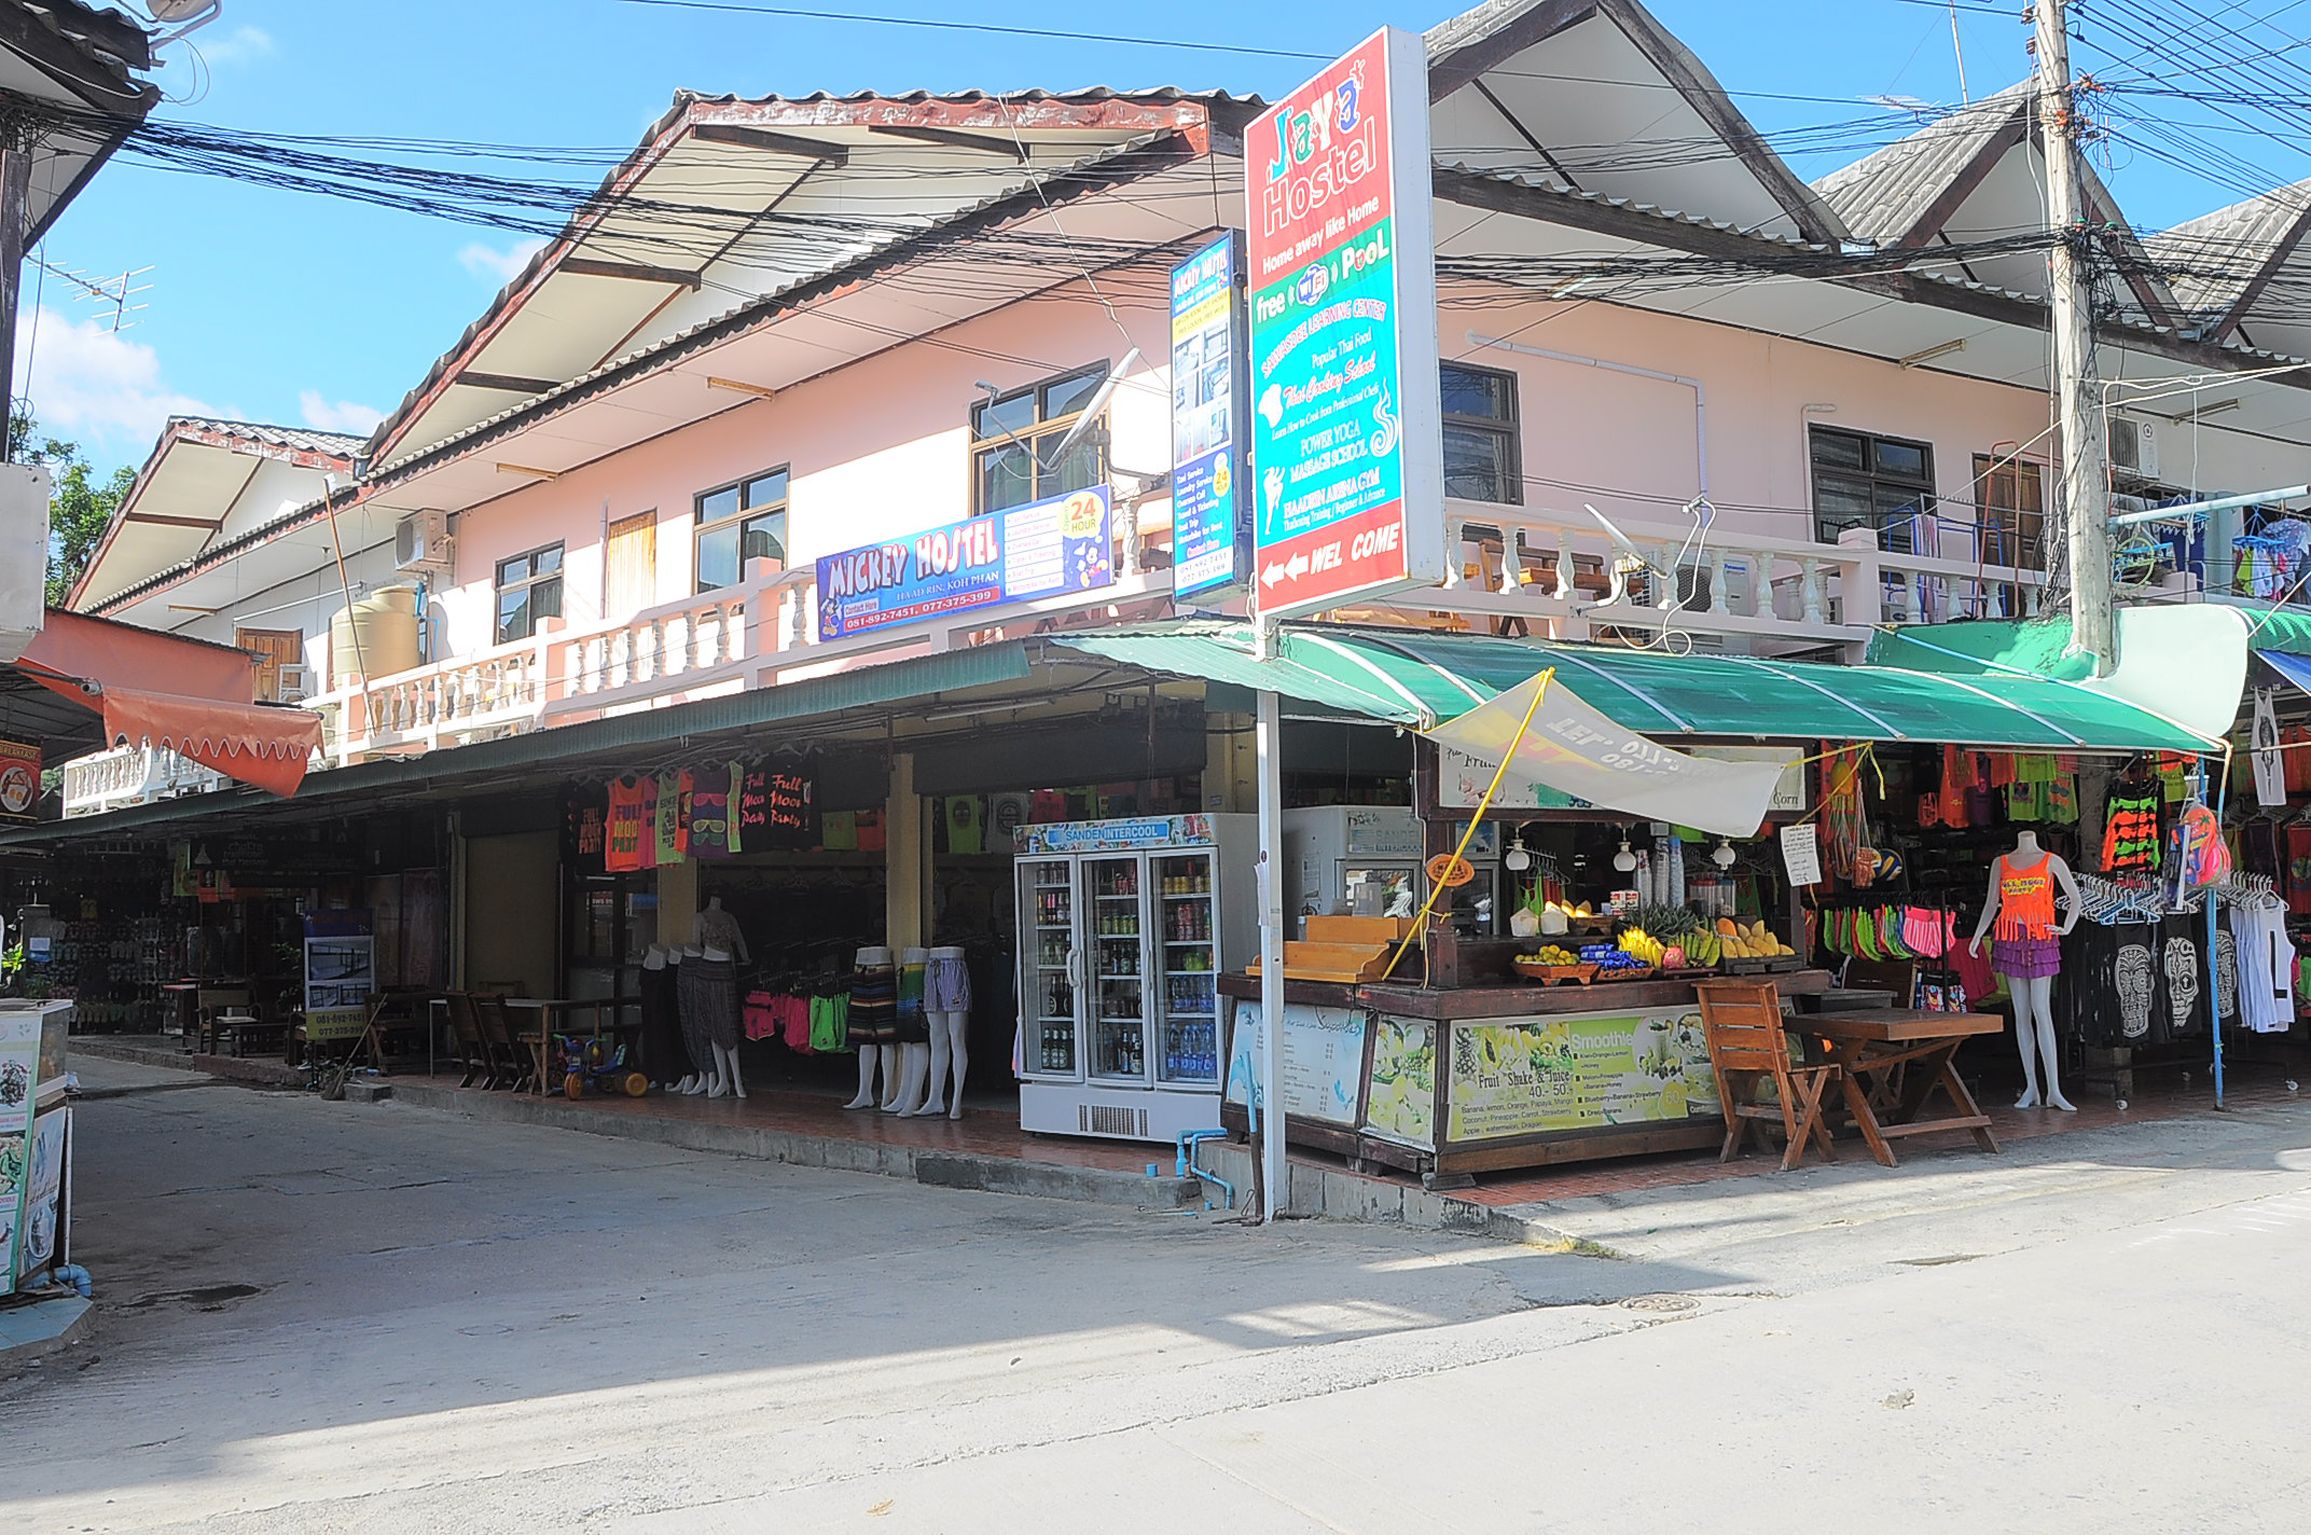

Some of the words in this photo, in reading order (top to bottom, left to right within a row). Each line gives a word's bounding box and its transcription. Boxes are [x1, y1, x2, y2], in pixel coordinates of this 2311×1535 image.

[1263, 115, 1376, 238] Hostel
[1263, 250, 1294, 275] Home
[1295, 229, 1324, 259] away
[1325, 213, 1346, 239] like
[1347, 196, 1379, 227] Home
[1256, 289, 1286, 324] free
[1308, 300, 1352, 335] LEARNING
[1353, 298, 1387, 322] CENTER
[1312, 346, 1337, 369] Popular
[1338, 336, 1354, 356] Thai
[1355, 325, 1373, 348] Food
[1305, 370, 1344, 403] Cooking
[1344, 350, 1377, 384] School
[1301, 428, 1333, 457] POWER
[1334, 418, 1361, 444] YOGA
[1290, 452, 1331, 484] MASSAGE
[1331, 438, 1369, 467] SCHOOL
[1358, 466, 1381, 490] GYM
[1071, 498, 1096, 521] 24
[1072, 519, 1096, 532] HOUR
[828, 543, 909, 599] MICKEY
[916, 518, 999, 580] HOSTEL
[1310, 541, 1343, 574] WEL
[1351, 521, 1400, 561] COME
[897, 588, 926, 601] HAAD
[947, 577, 969, 590] KOH
[971, 570, 999, 585] PHAN
[772, 774, 802, 792] Full
[1773, 792, 1799, 807] Corn
[770, 808, 802, 829] Party
[1571, 1031, 1633, 1050] Smoothie
[1478, 1072, 1500, 1089] Fruit
[1507, 1070, 1533, 1086] Shake
[1536, 1073, 1545, 1084] &
[1549, 1069, 1571, 1083] Juice
